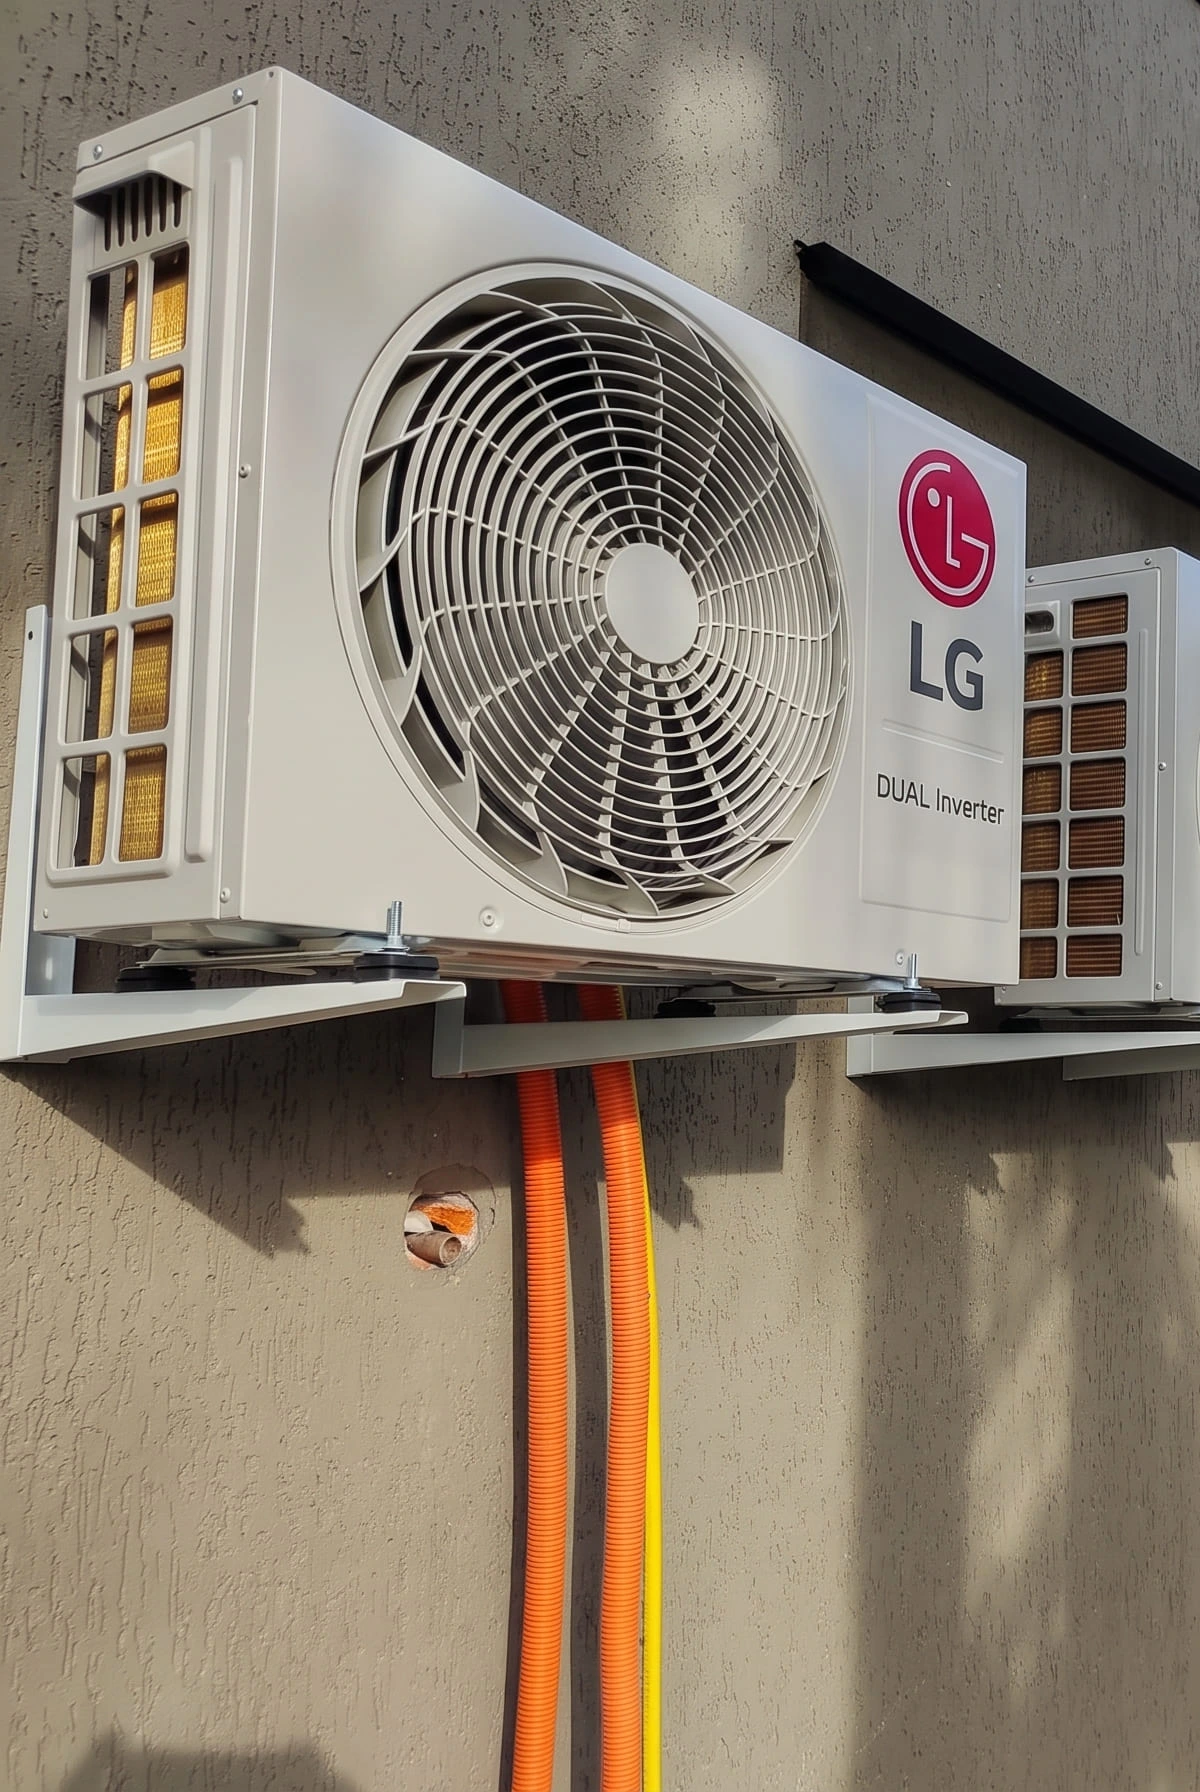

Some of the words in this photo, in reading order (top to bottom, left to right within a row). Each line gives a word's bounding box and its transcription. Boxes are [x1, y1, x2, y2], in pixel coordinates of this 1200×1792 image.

[910, 621, 984, 711] LG
[877, 773, 930, 810] DUAL
[936, 786, 1005, 826] Inverter
